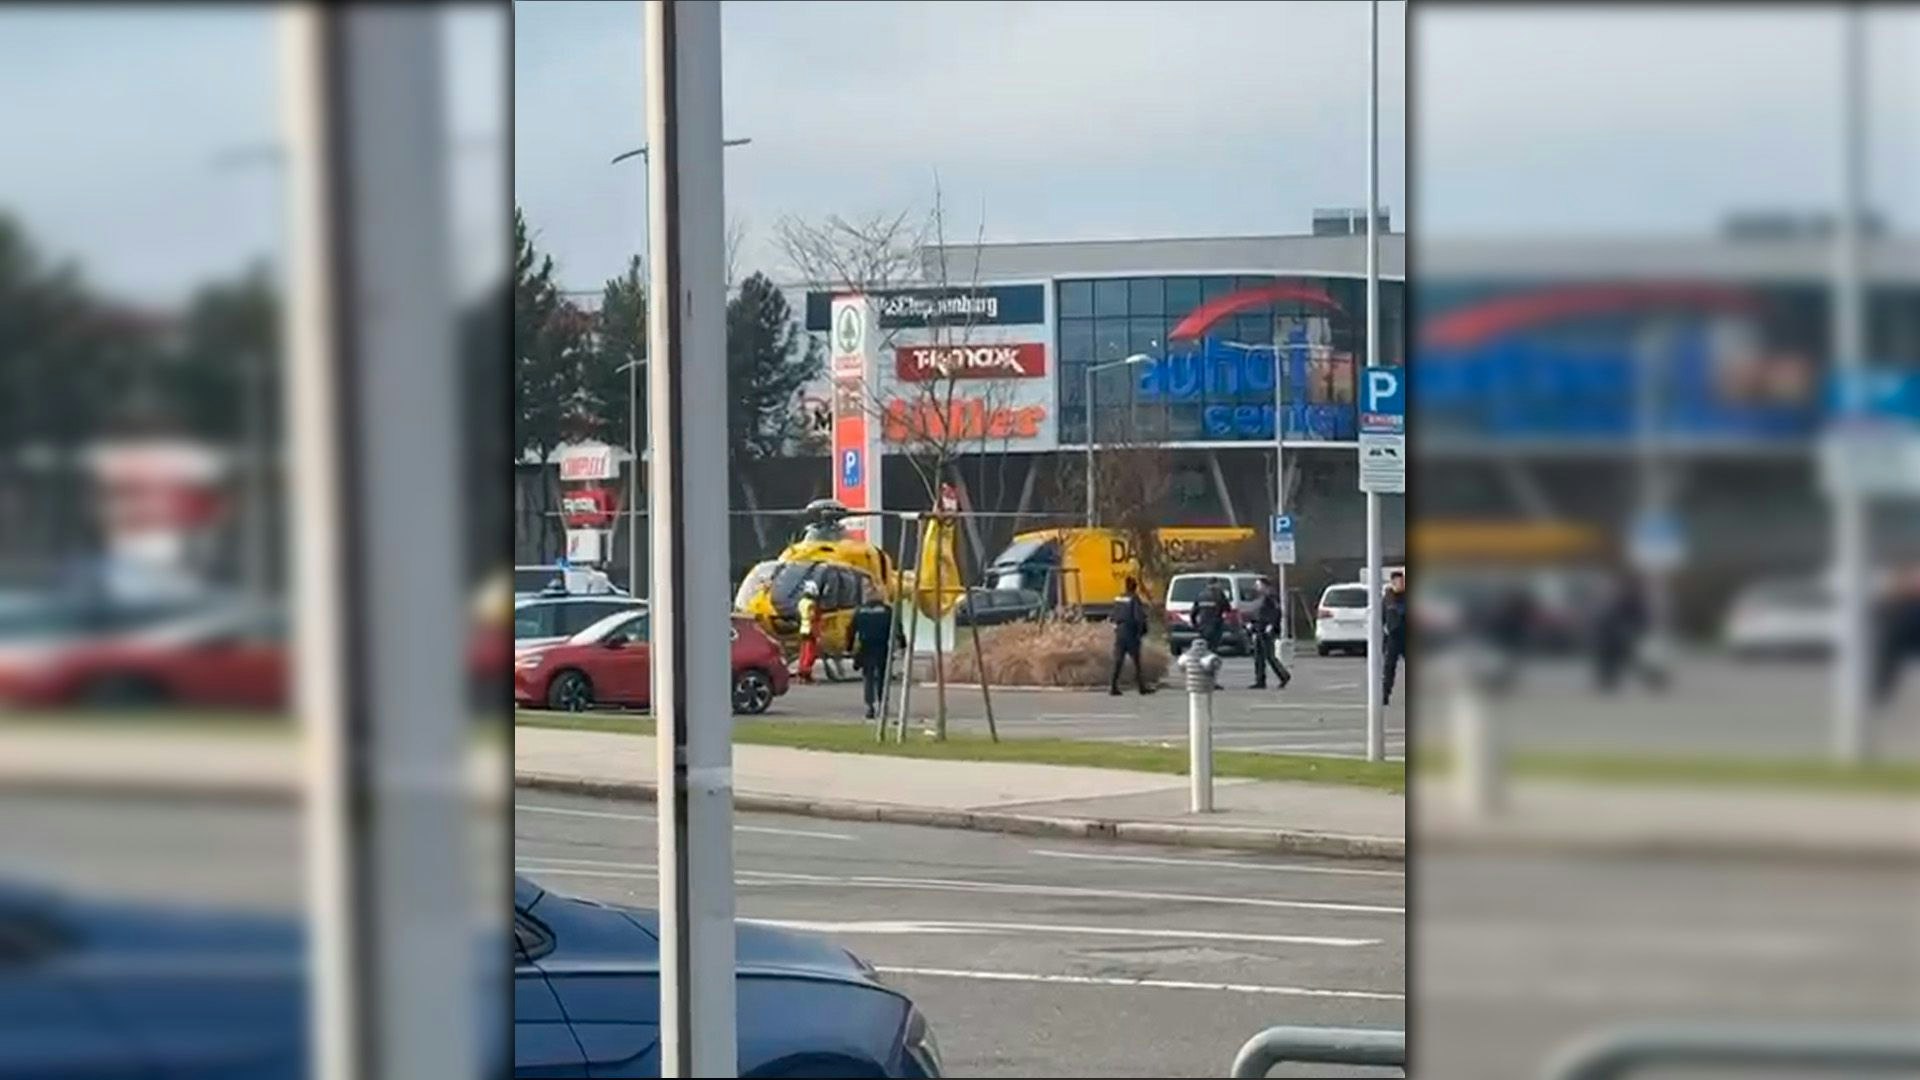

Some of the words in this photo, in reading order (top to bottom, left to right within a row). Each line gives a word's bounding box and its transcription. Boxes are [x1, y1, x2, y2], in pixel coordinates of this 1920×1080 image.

[1368, 371, 1397, 411] P
[846, 451, 857, 475] P
[1276, 516, 1290, 533] P
